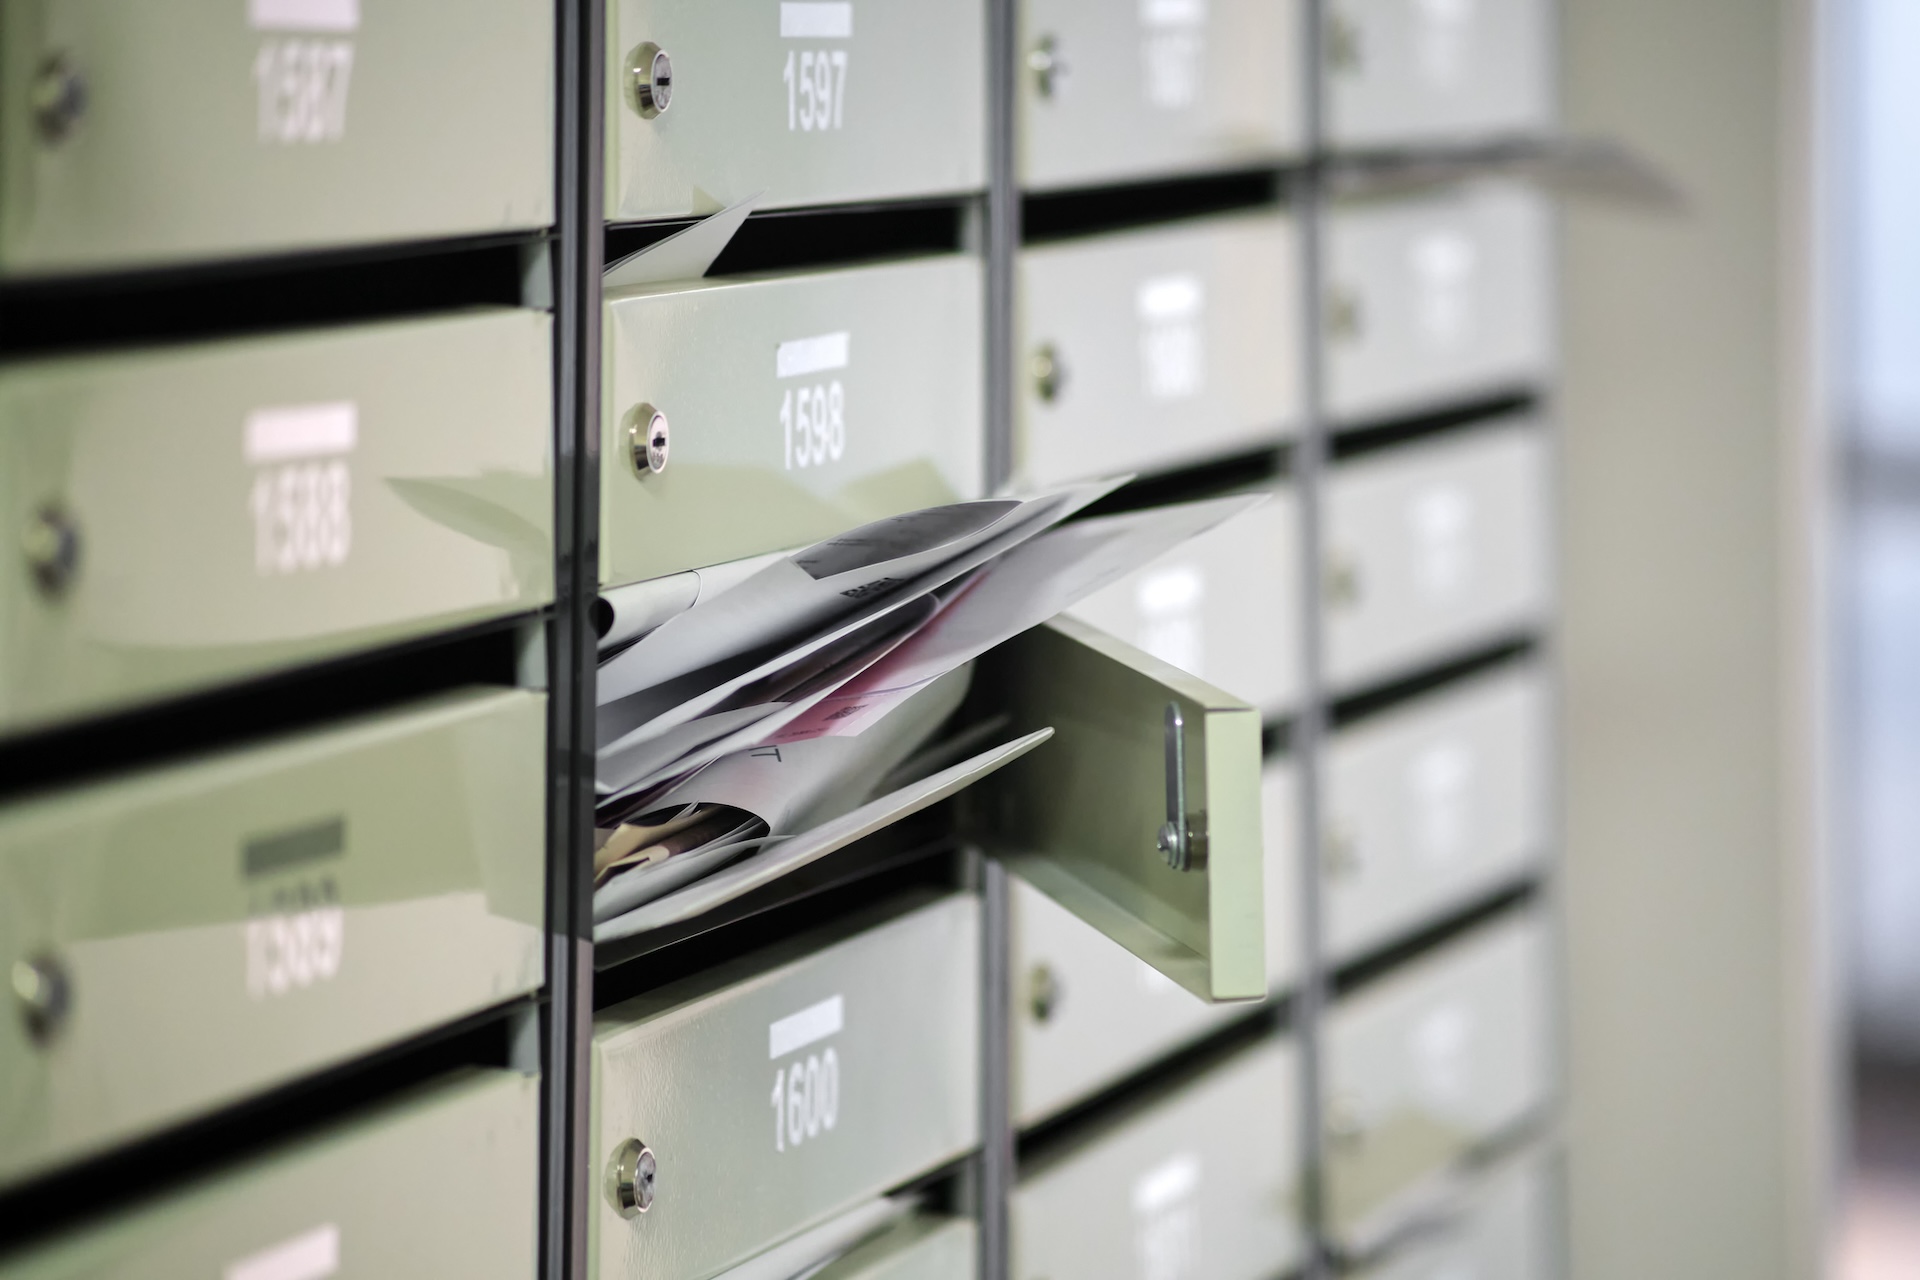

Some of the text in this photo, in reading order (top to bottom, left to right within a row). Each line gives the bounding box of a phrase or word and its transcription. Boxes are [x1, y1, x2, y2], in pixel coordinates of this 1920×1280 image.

[783, 49, 848, 131] 1597
[780, 380, 846, 470] 1598
[771, 1046, 839, 1152] 1600
